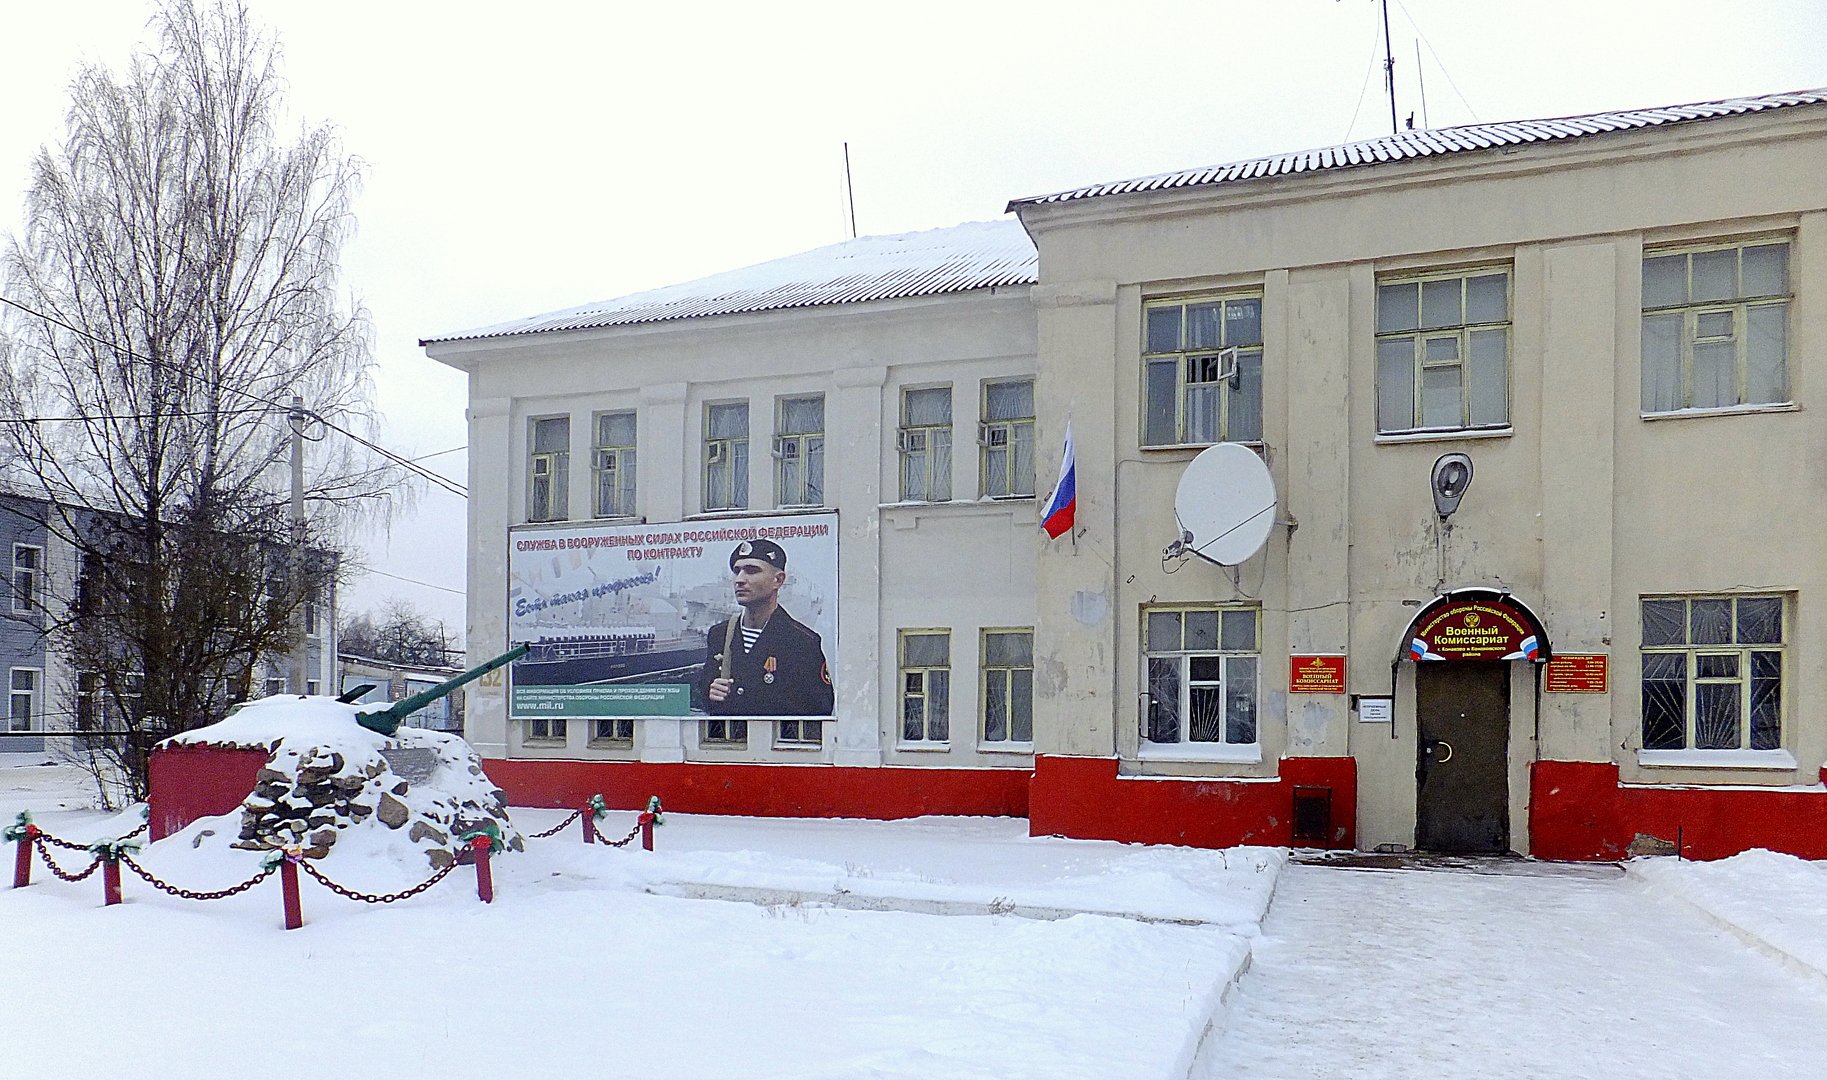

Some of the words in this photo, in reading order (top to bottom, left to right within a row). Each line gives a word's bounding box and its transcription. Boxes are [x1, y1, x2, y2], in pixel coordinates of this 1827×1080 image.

[517, 539, 557, 552] СЛУЖБА
[558, 538, 566, 550] В
[567, 534, 645, 549] ВООРУЖЕННЫХ
[645, 533, 682, 545] СИЛАХ
[684, 527, 757, 543] РОССИЙСКОЙ
[758, 525, 829, 540] ФЕДЕРАЦИИ
[627, 549, 643, 561] ПО
[643, 547, 703, 560] КОНТРАКТУ
[1420, 612, 1450, 637] Министерство
[1450, 605, 1473, 615] обороны
[1473, 605, 1503, 617] Российской
[1502, 613, 1525, 635] Федерации
[1446, 625, 1498, 636] Военный
[1434, 635, 1509, 645] Комиссариат
[516, 701, 564, 710] www.mil.ru
